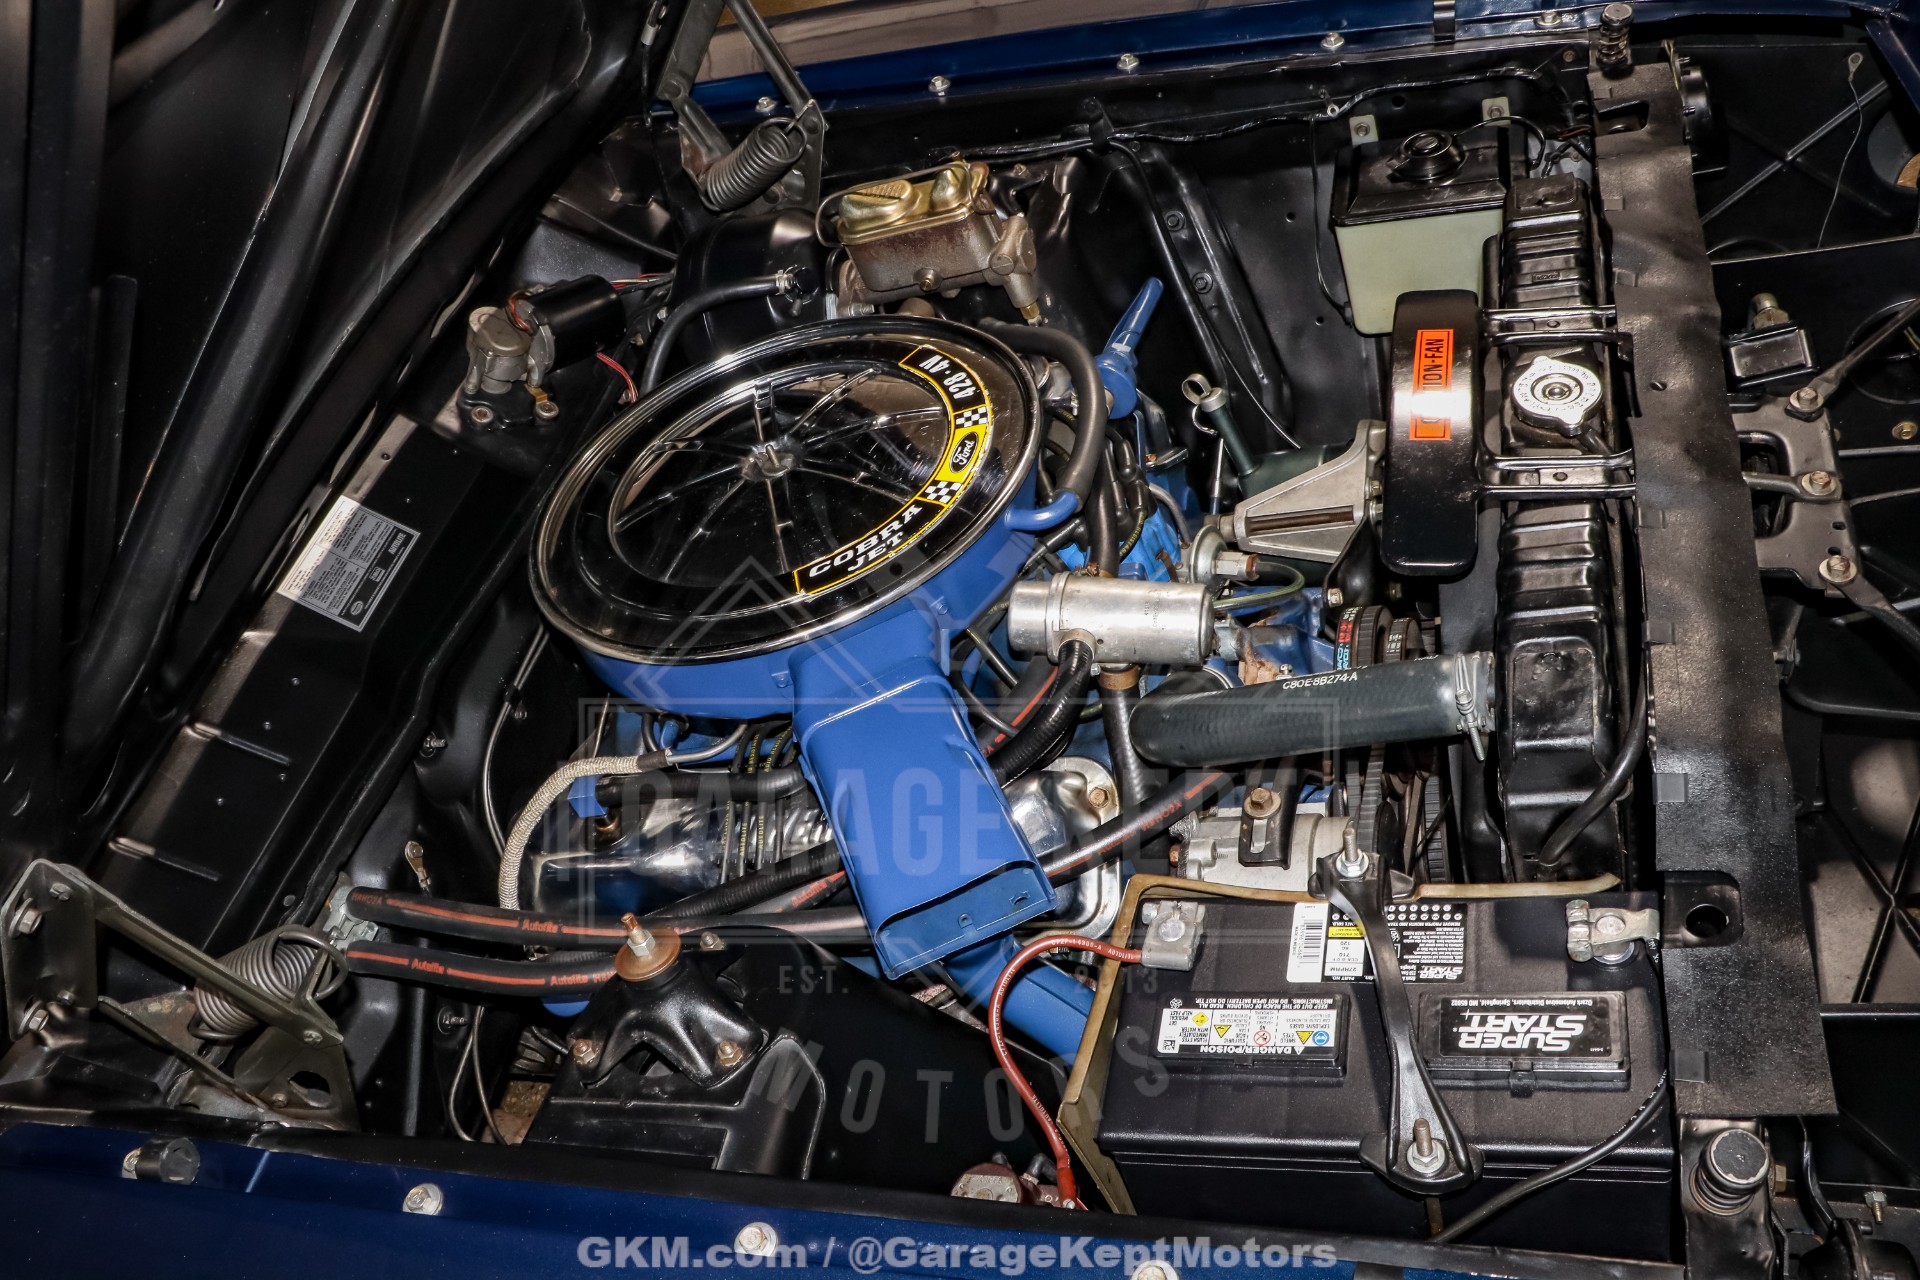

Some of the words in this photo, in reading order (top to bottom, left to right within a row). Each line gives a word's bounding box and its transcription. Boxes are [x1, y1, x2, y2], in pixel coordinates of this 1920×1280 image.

[952, 440, 976, 465] Ford
[809, 504, 923, 578] COBRA
[848, 531, 904, 572] JET
[739, 822, 748, 857] AUTOLITE
[522, 919, 558, 934] Autolite
[411, 958, 445, 975] Autolite
[1419, 971, 1457, 979] SUPER
[1421, 966, 1463, 974] START
[550, 970, 589, 989] Autolite
[1458, 1014, 1587, 1035] START
[1200, 1045, 1291, 1054] DANGER/POISON
[1458, 1033, 1572, 1051] SUPER
